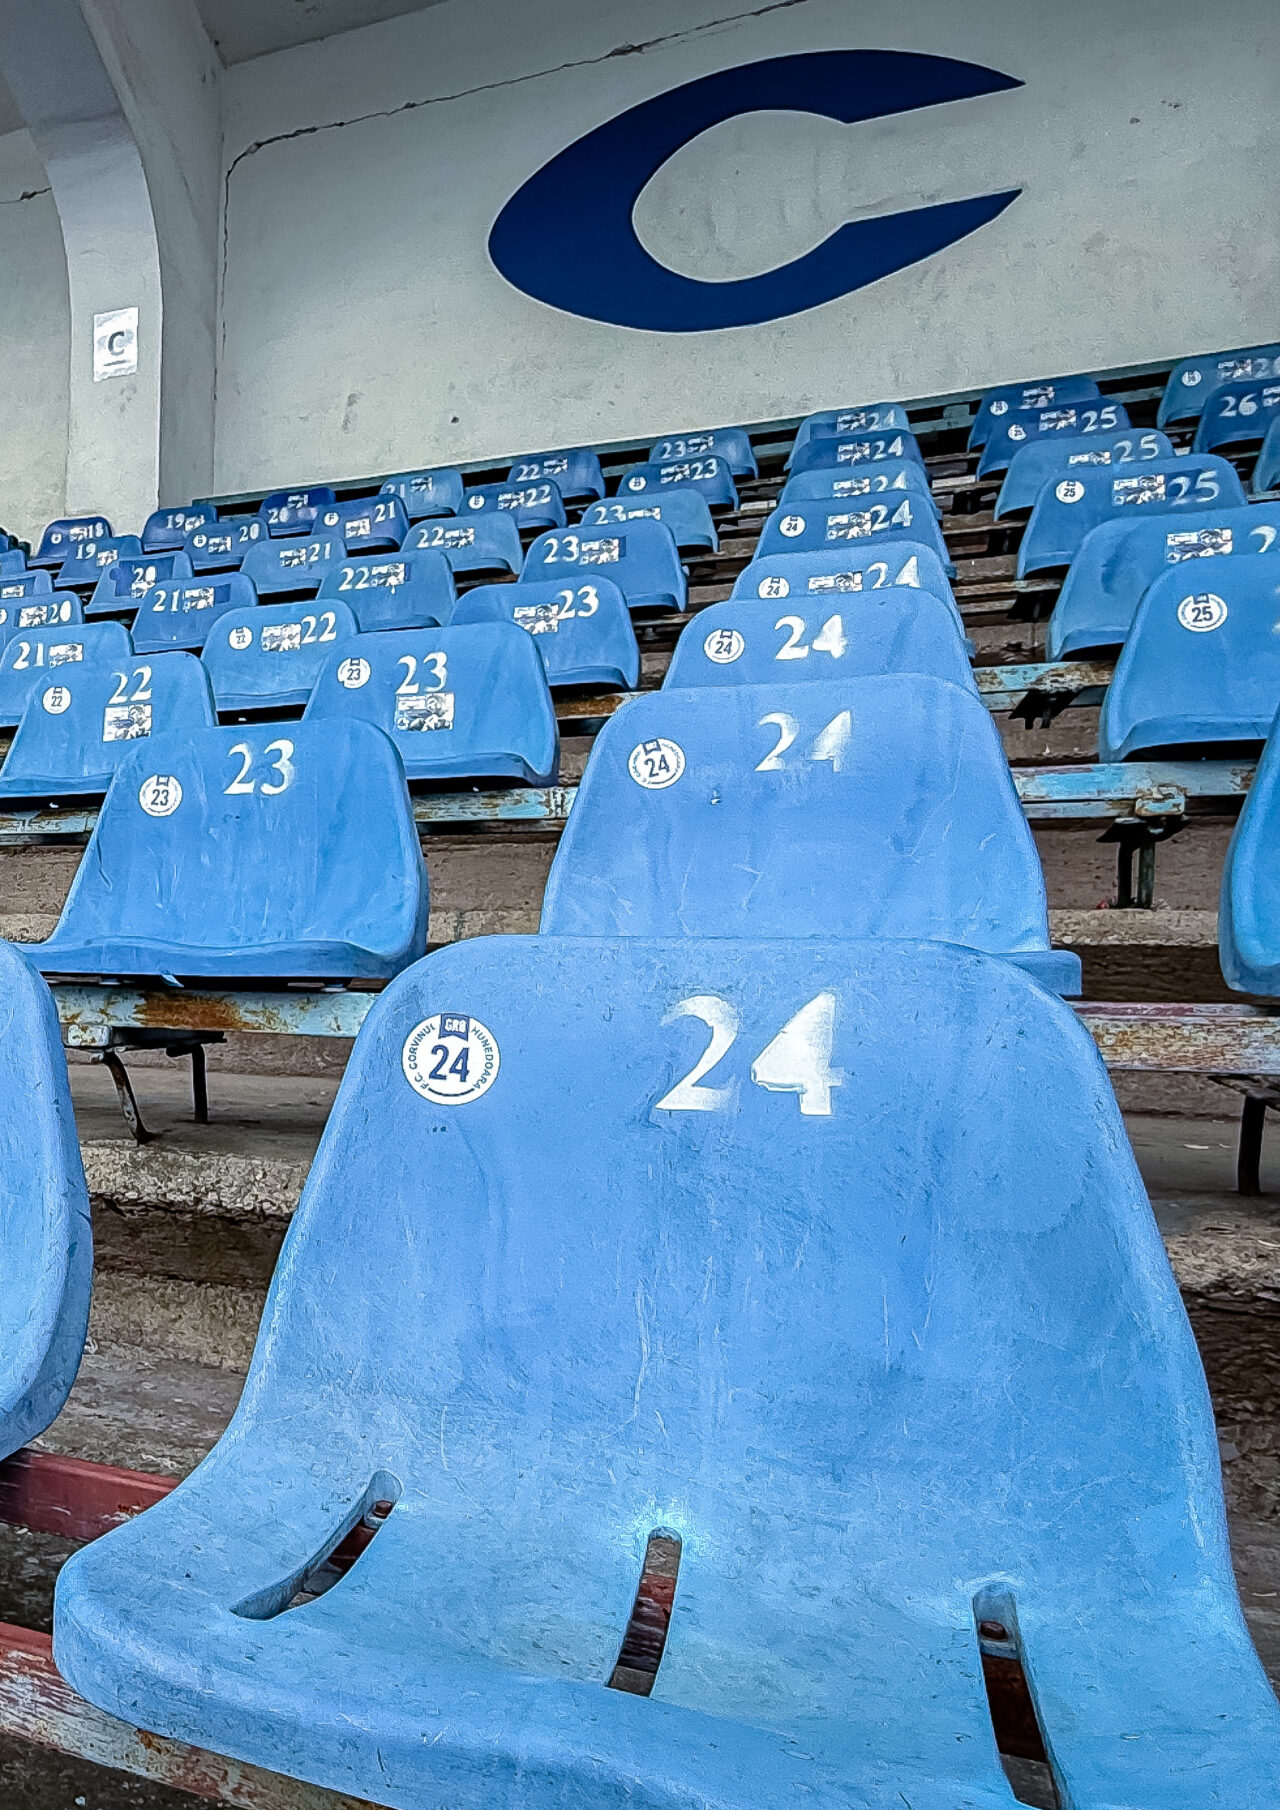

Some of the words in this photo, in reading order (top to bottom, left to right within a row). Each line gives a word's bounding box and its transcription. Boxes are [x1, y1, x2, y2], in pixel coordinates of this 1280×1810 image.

[488, 49, 1026, 333] C
[108, 332, 125, 355] C
[1219, 393, 1258, 417] 26
[867, 409, 896, 431] 24
[1081, 405, 1118, 432] 25
[661, 440, 686, 459] 23
[872, 435, 904, 460] 24
[1113, 434, 1160, 463] 25
[516, 464, 541, 482] 22
[690, 458, 718, 481] 23
[872, 470, 907, 492] 24
[385, 484, 406, 498] 21
[525, 485, 551, 507] 22
[1064, 488, 1075, 498] 25
[1167, 469, 1220, 503] 25
[166, 513, 185, 529] 19
[268, 508, 290, 524] 20
[374, 501, 396, 523] 21
[870, 500, 913, 531] 24
[88, 522, 103, 537] 18
[239, 523, 260, 542] 20
[417, 526, 444, 548] 22
[786, 523, 797, 532] 24
[76, 543, 96, 559] 19
[308, 542, 331, 561] 21
[543, 535, 580, 564] 23
[134, 566, 157, 583] 20
[338, 567, 370, 591] 22
[865, 555, 921, 590] 24
[152, 589, 180, 612] 21
[557, 585, 599, 620] 23
[768, 587, 781, 596] 24
[48, 600, 71, 623] 20
[1192, 606, 1213, 622] 25
[301, 612, 336, 644] 22
[774, 615, 846, 660] 24
[12, 642, 44, 670] 21
[714, 641, 731, 655] 24
[347, 669, 361, 681] 23
[395, 652, 448, 694] 23
[108, 666, 152, 704] 22
[51, 696, 63, 707] 22
[754, 710, 851, 772] 24
[224, 739, 295, 795] 23
[644, 754, 670, 777] 24
[151, 789, 169, 806] 23
[429, 1044, 470, 1082] 24
[471, 1025, 494, 1090] HUNEDOARA
[654, 991, 844, 1116] 24
